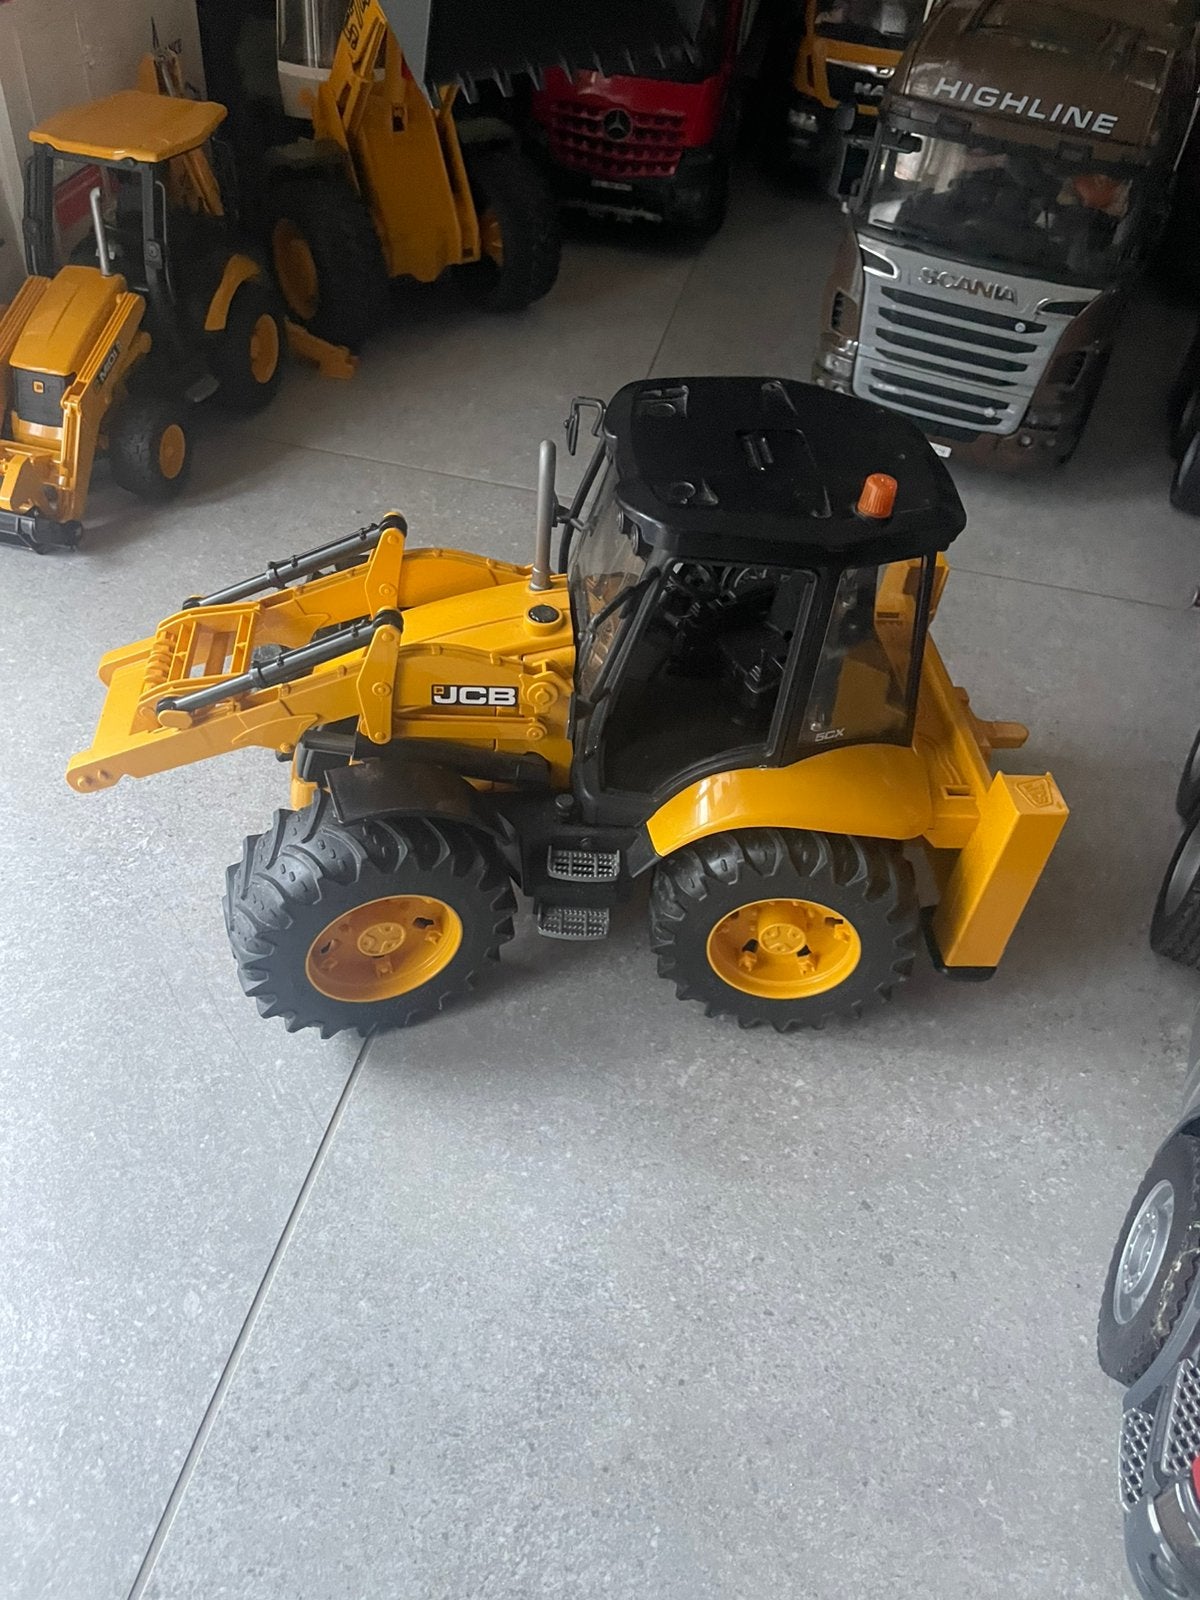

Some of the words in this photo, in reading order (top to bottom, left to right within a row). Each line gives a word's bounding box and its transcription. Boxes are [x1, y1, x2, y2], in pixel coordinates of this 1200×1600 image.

[853, 82, 885, 97] MA
[932, 77, 1119, 135] HIGHLINE
[918, 266, 1018, 306] SCANIA
[433, 686, 516, 706] JCB
